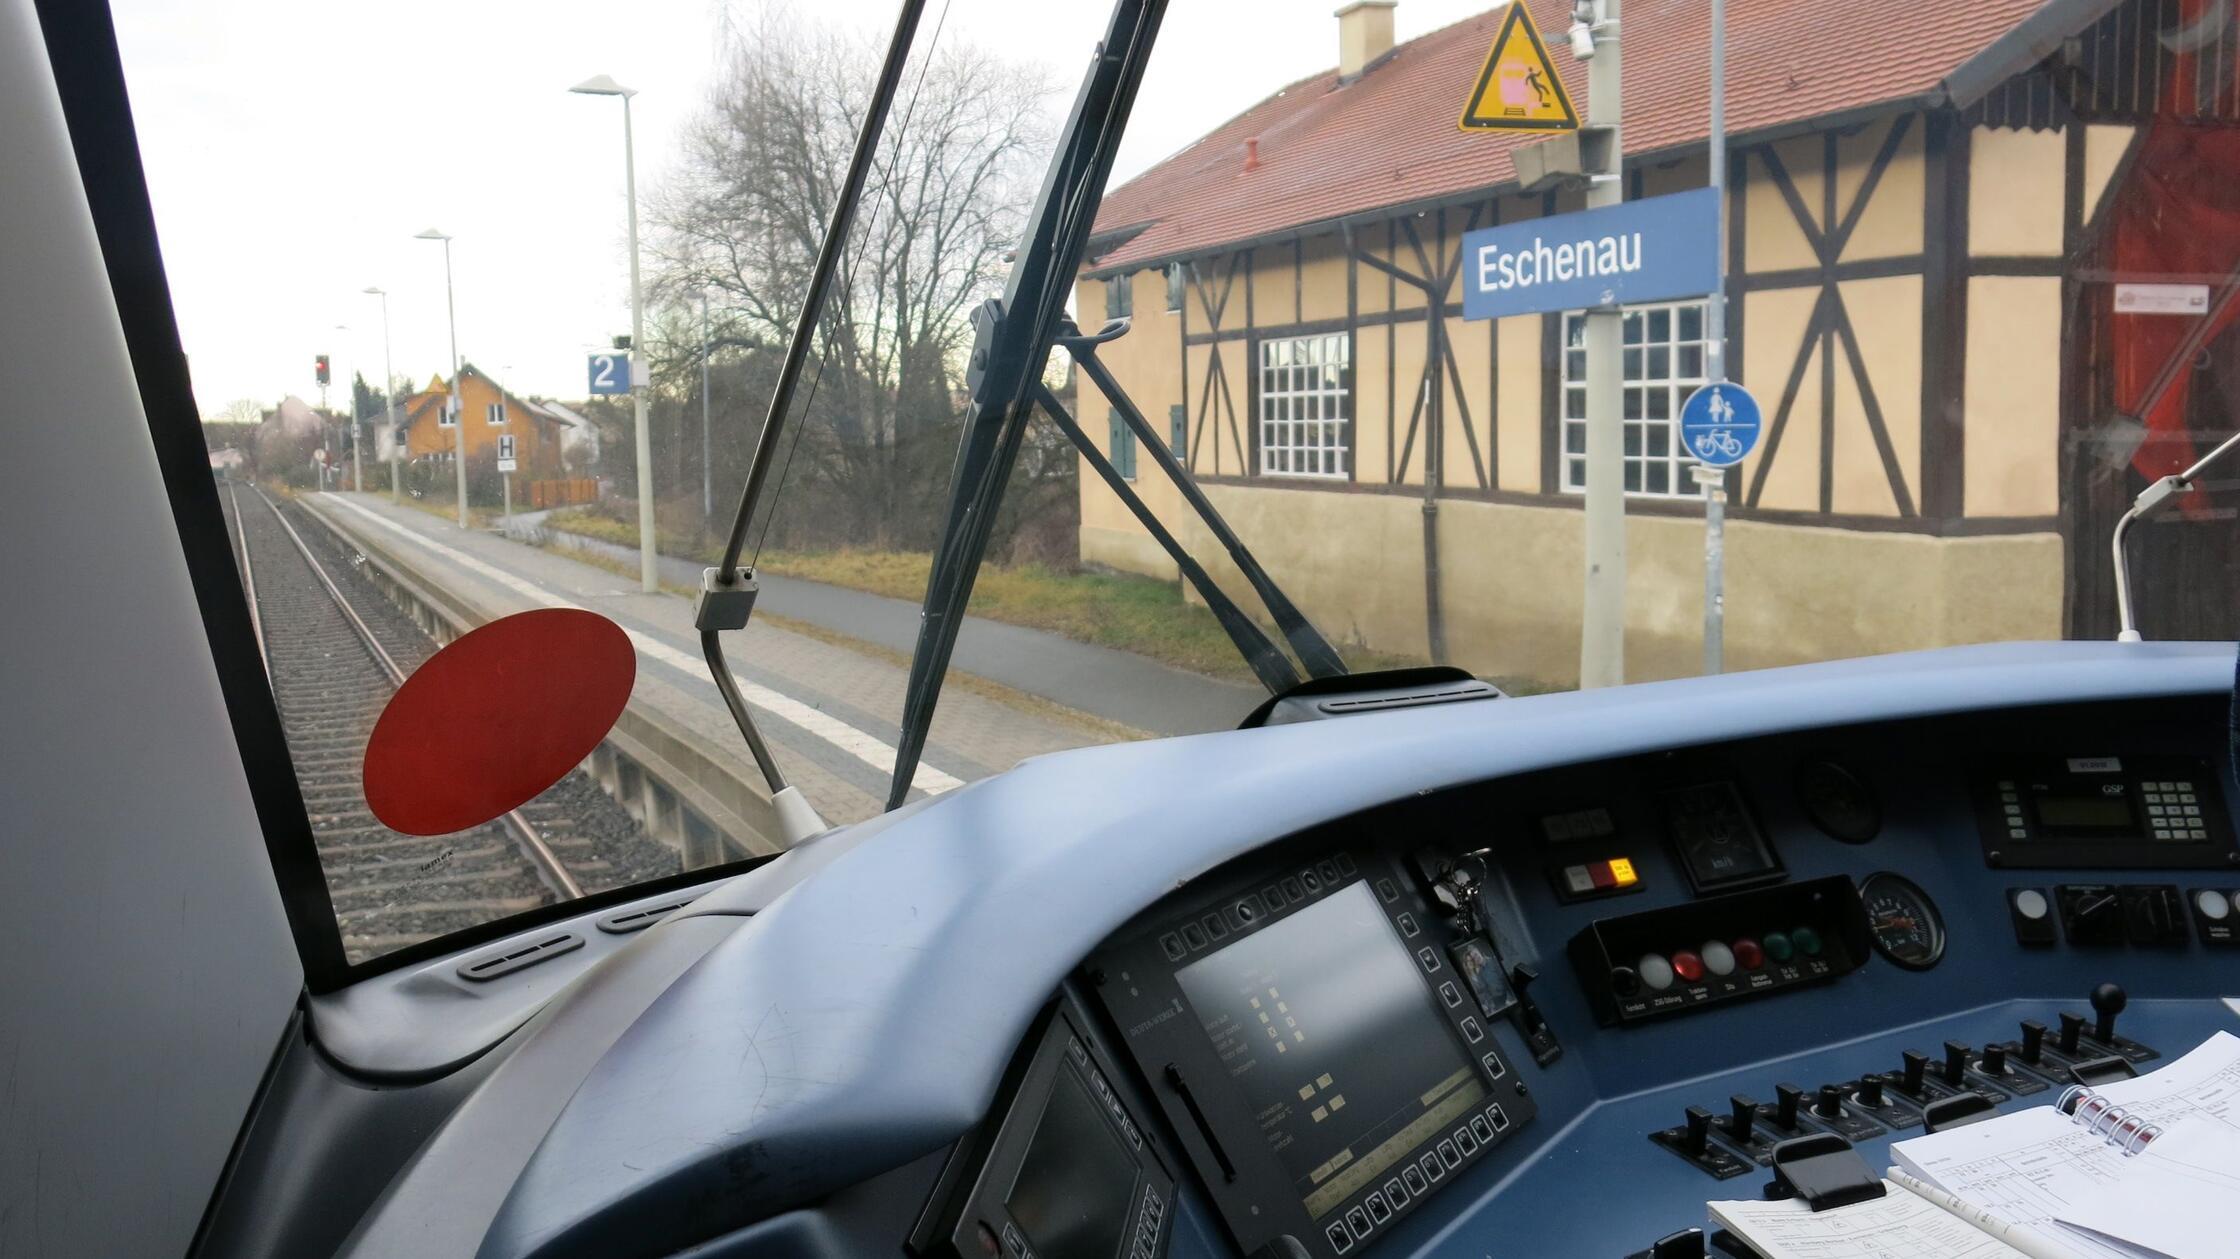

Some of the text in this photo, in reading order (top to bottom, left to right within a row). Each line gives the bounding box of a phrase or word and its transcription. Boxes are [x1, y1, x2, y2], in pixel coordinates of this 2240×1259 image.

[1478, 232, 1641, 292] Eschenau
[594, 355, 614, 387] 2
[500, 437, 513, 456] H
[2102, 784, 2124, 793] GSP
